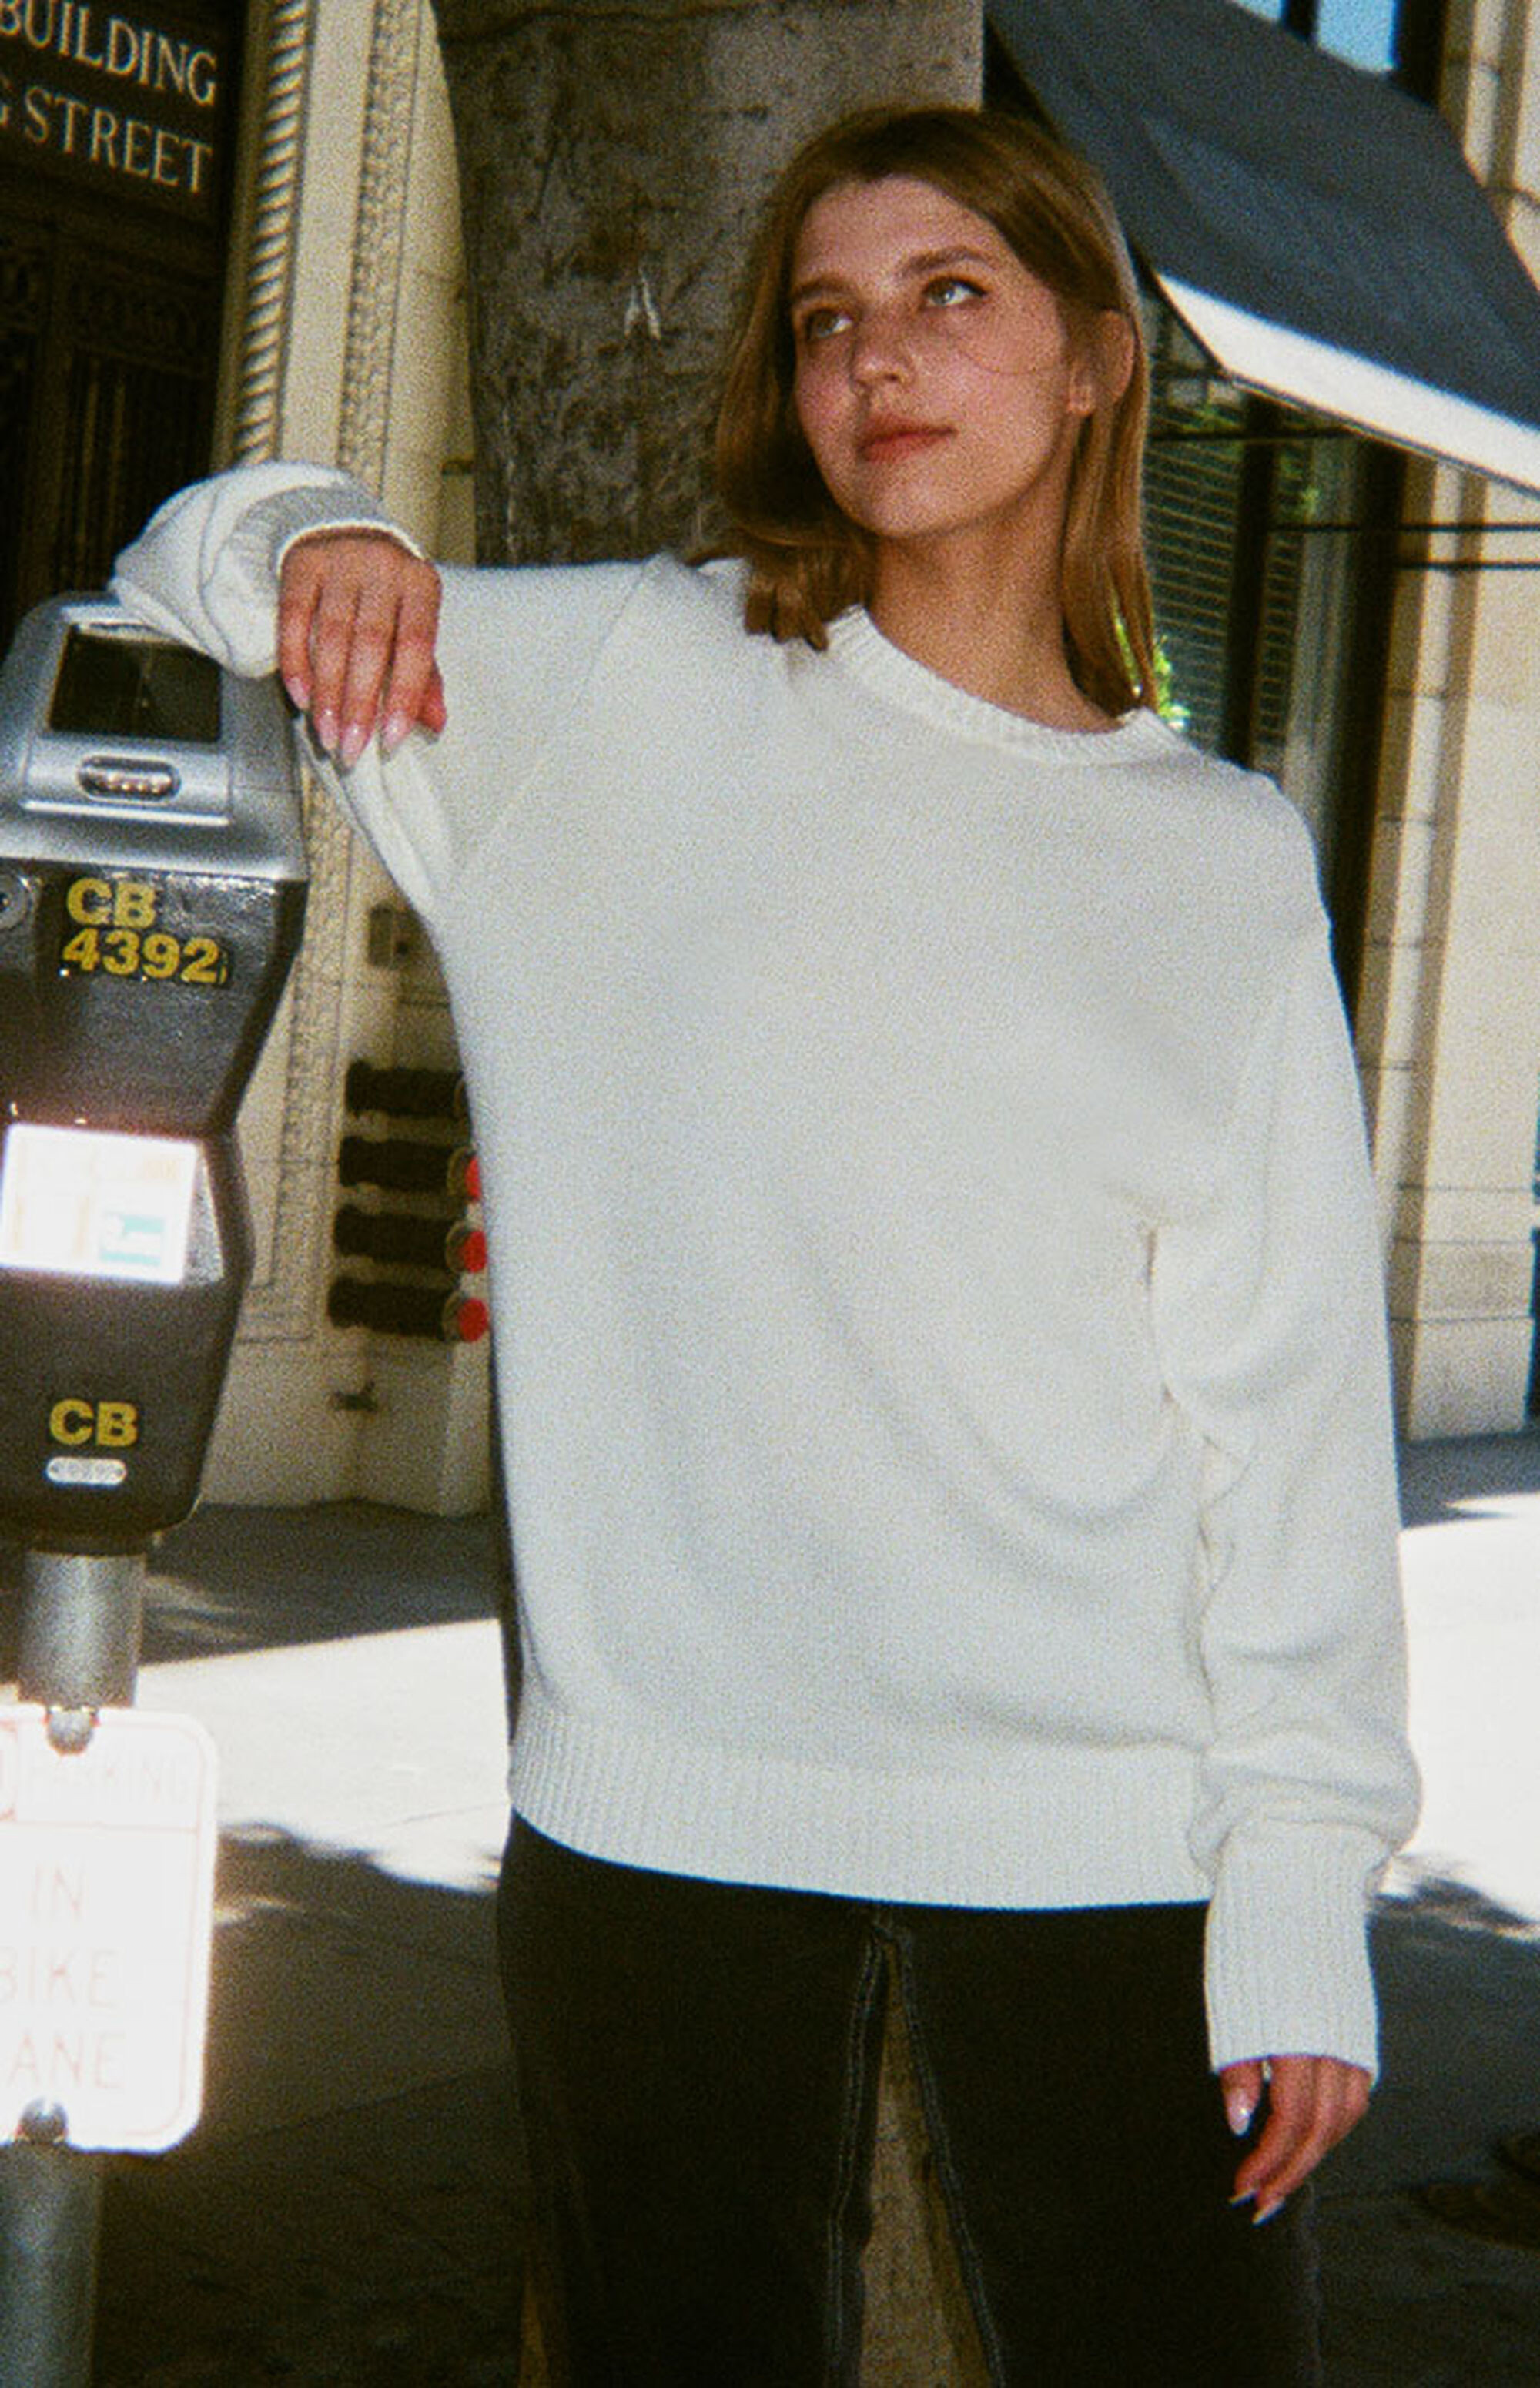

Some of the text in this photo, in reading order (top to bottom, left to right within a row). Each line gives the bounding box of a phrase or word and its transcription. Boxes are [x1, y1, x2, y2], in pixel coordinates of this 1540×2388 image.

[24, 85, 213, 193] STREET
[66, 877, 156, 929] CB
[62, 927, 219, 983] 4392
[49, 1398, 139, 1447] CB
[31, 1864, 85, 1922] IN
